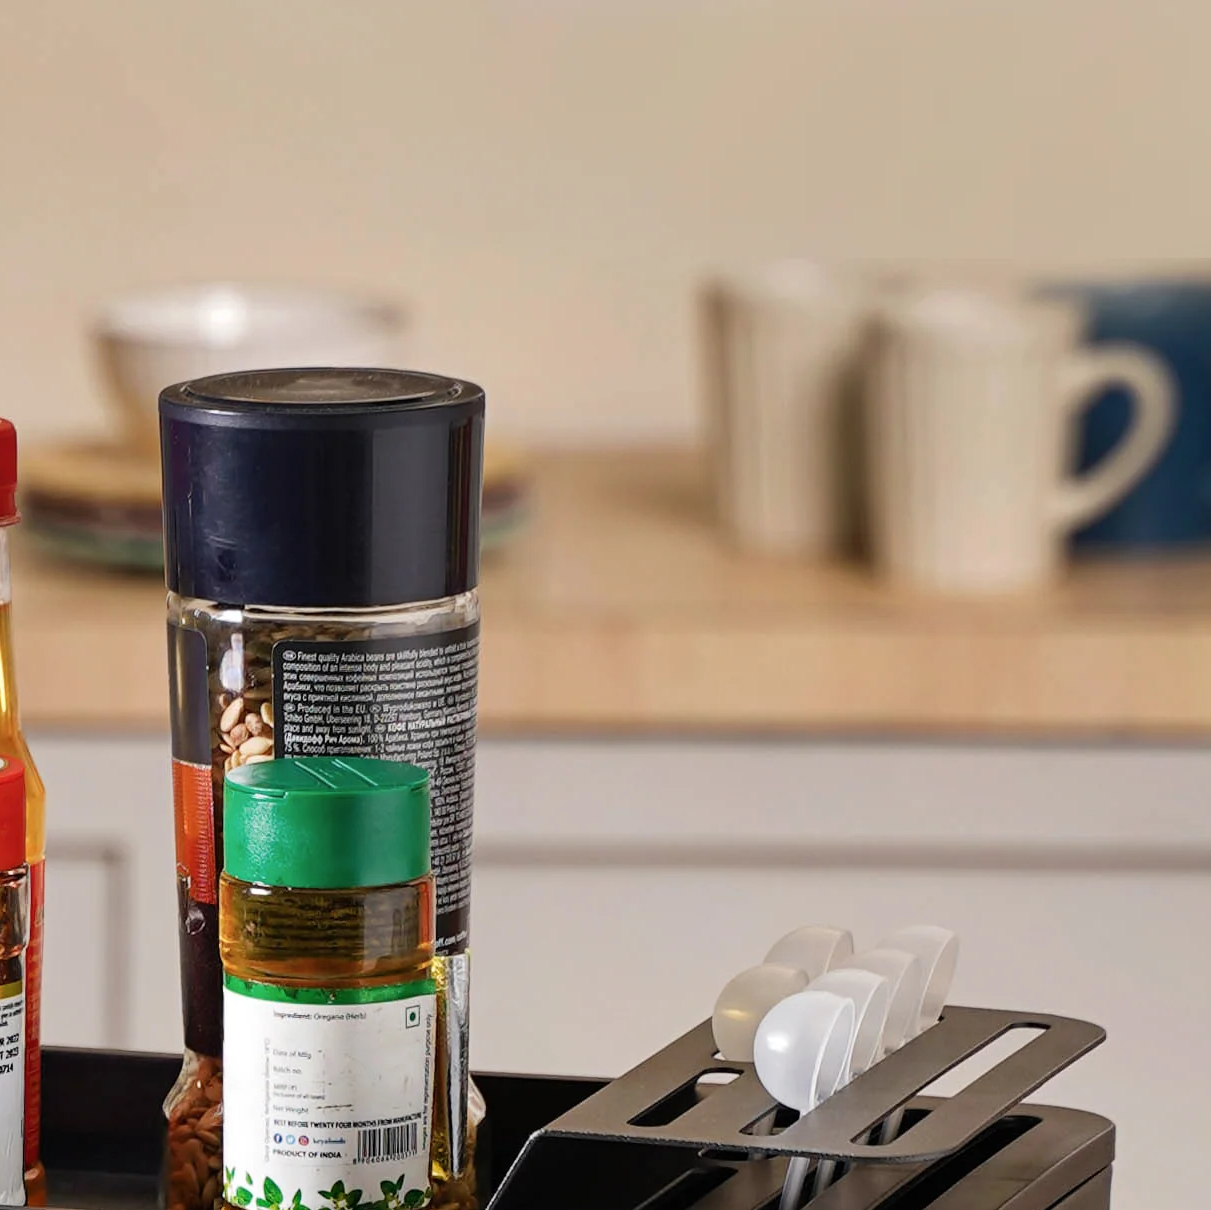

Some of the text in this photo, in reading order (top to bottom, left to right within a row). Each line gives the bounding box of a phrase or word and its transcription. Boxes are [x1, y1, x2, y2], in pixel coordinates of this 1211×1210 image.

[298, 651, 317, 661] Finest
[318, 653, 339, 663] quality
[341, 653, 365, 662] Arabica
[298, 703, 332, 713] Produced
[342, 705, 354, 714] the
[314, 1013, 345, 1022] Oregano
[311, 1121, 334, 1129] TWENTY
[336, 1121, 352, 1129] FOUR
[353, 1119, 377, 1129] MONTHS
[273, 1149, 341, 1159] PRODUCT OF INDIA
